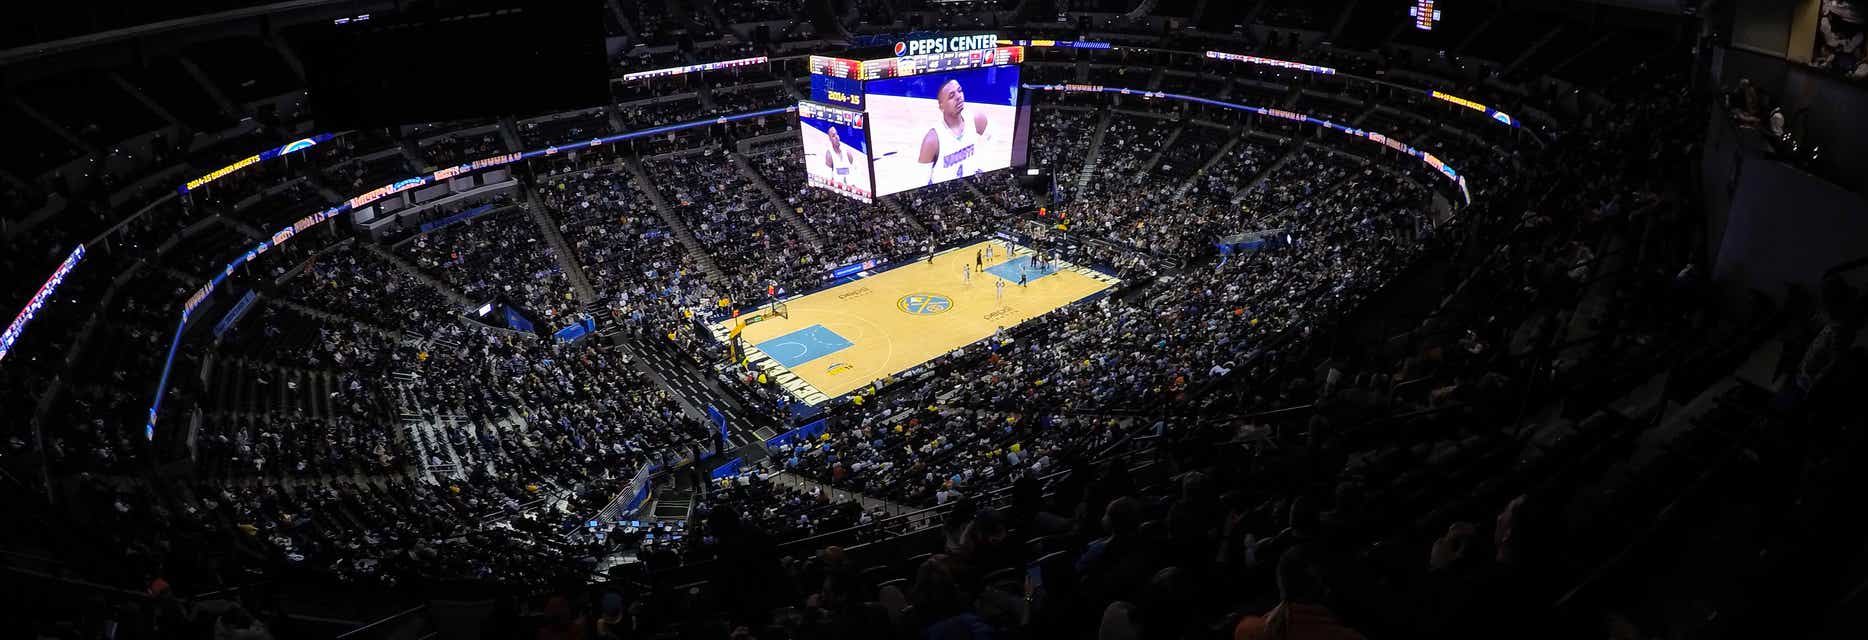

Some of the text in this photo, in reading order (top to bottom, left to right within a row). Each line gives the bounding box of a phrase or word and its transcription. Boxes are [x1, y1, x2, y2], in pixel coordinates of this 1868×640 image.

[909, 34, 998, 55] PEPSI CENTER
[828, 90, 860, 105] 2014-15
[187, 154, 260, 190] 2014-15 DENVER NUGGETS
